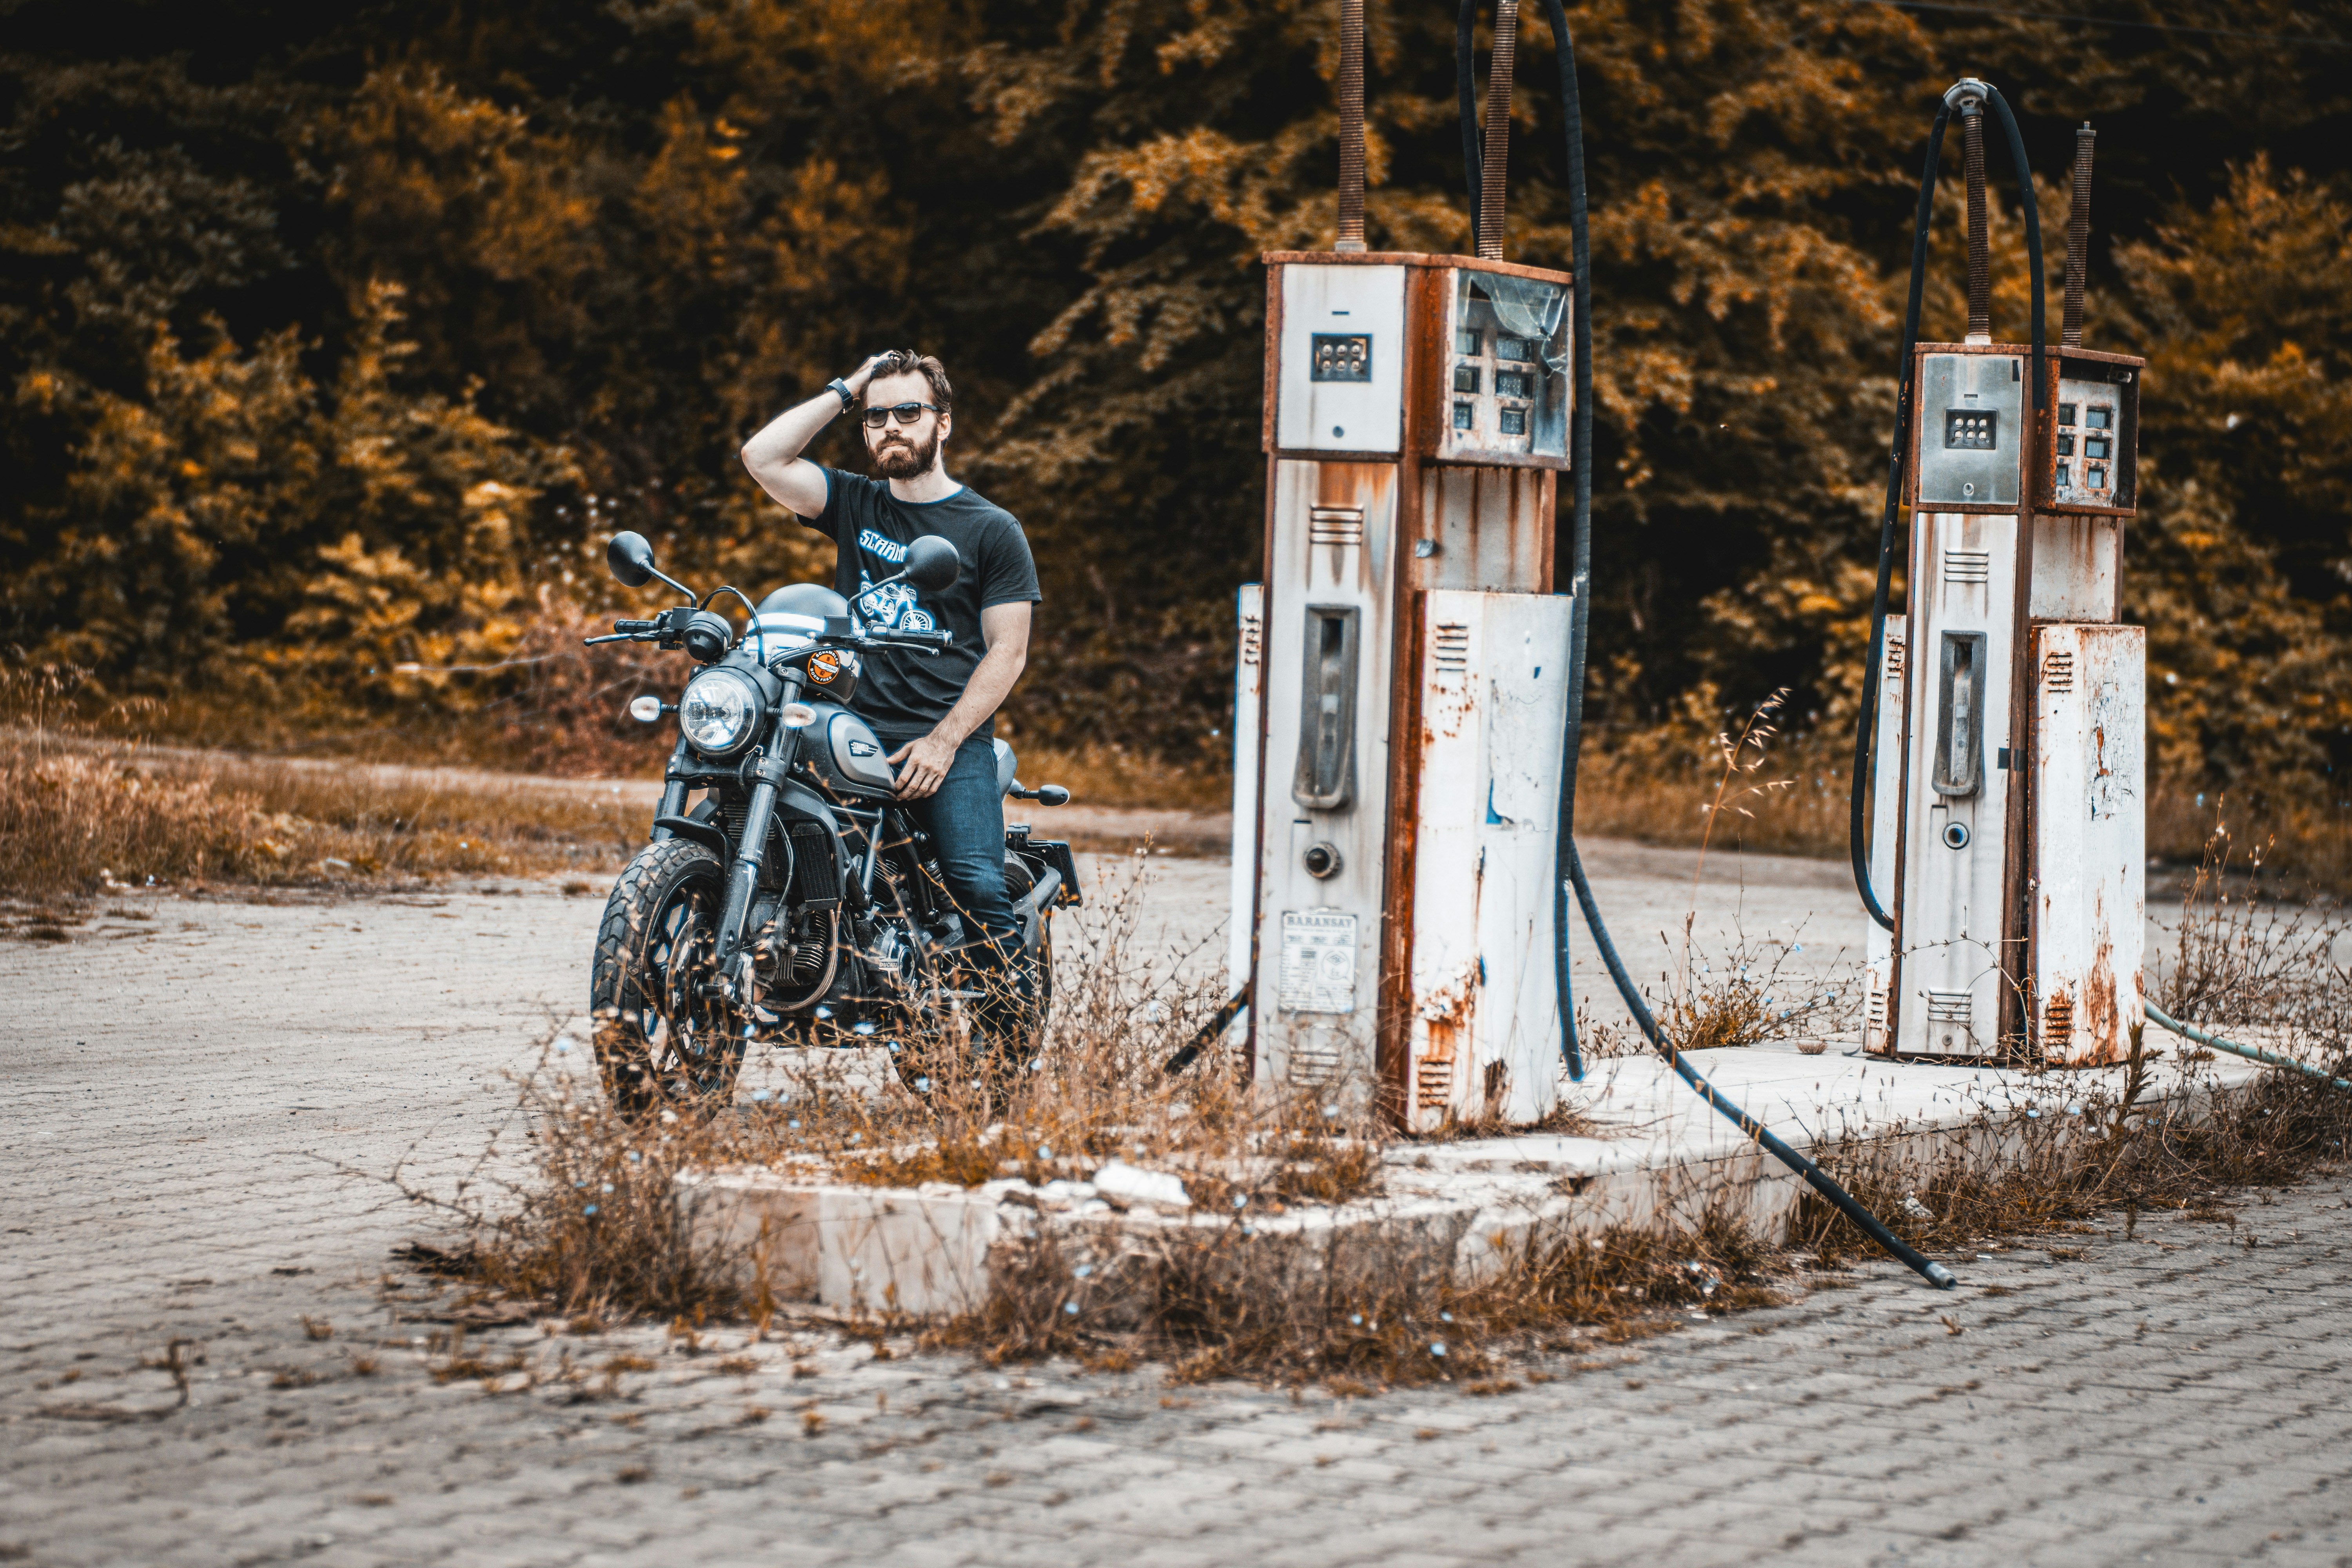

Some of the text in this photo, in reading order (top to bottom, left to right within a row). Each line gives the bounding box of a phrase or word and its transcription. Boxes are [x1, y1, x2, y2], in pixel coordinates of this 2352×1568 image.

[860, 529, 907, 562] SCRAM
[815, 651, 838, 665] SCRAMBLER
[810, 668, 820, 681] BORN
[1287, 916, 1352, 927] BARANSAY
